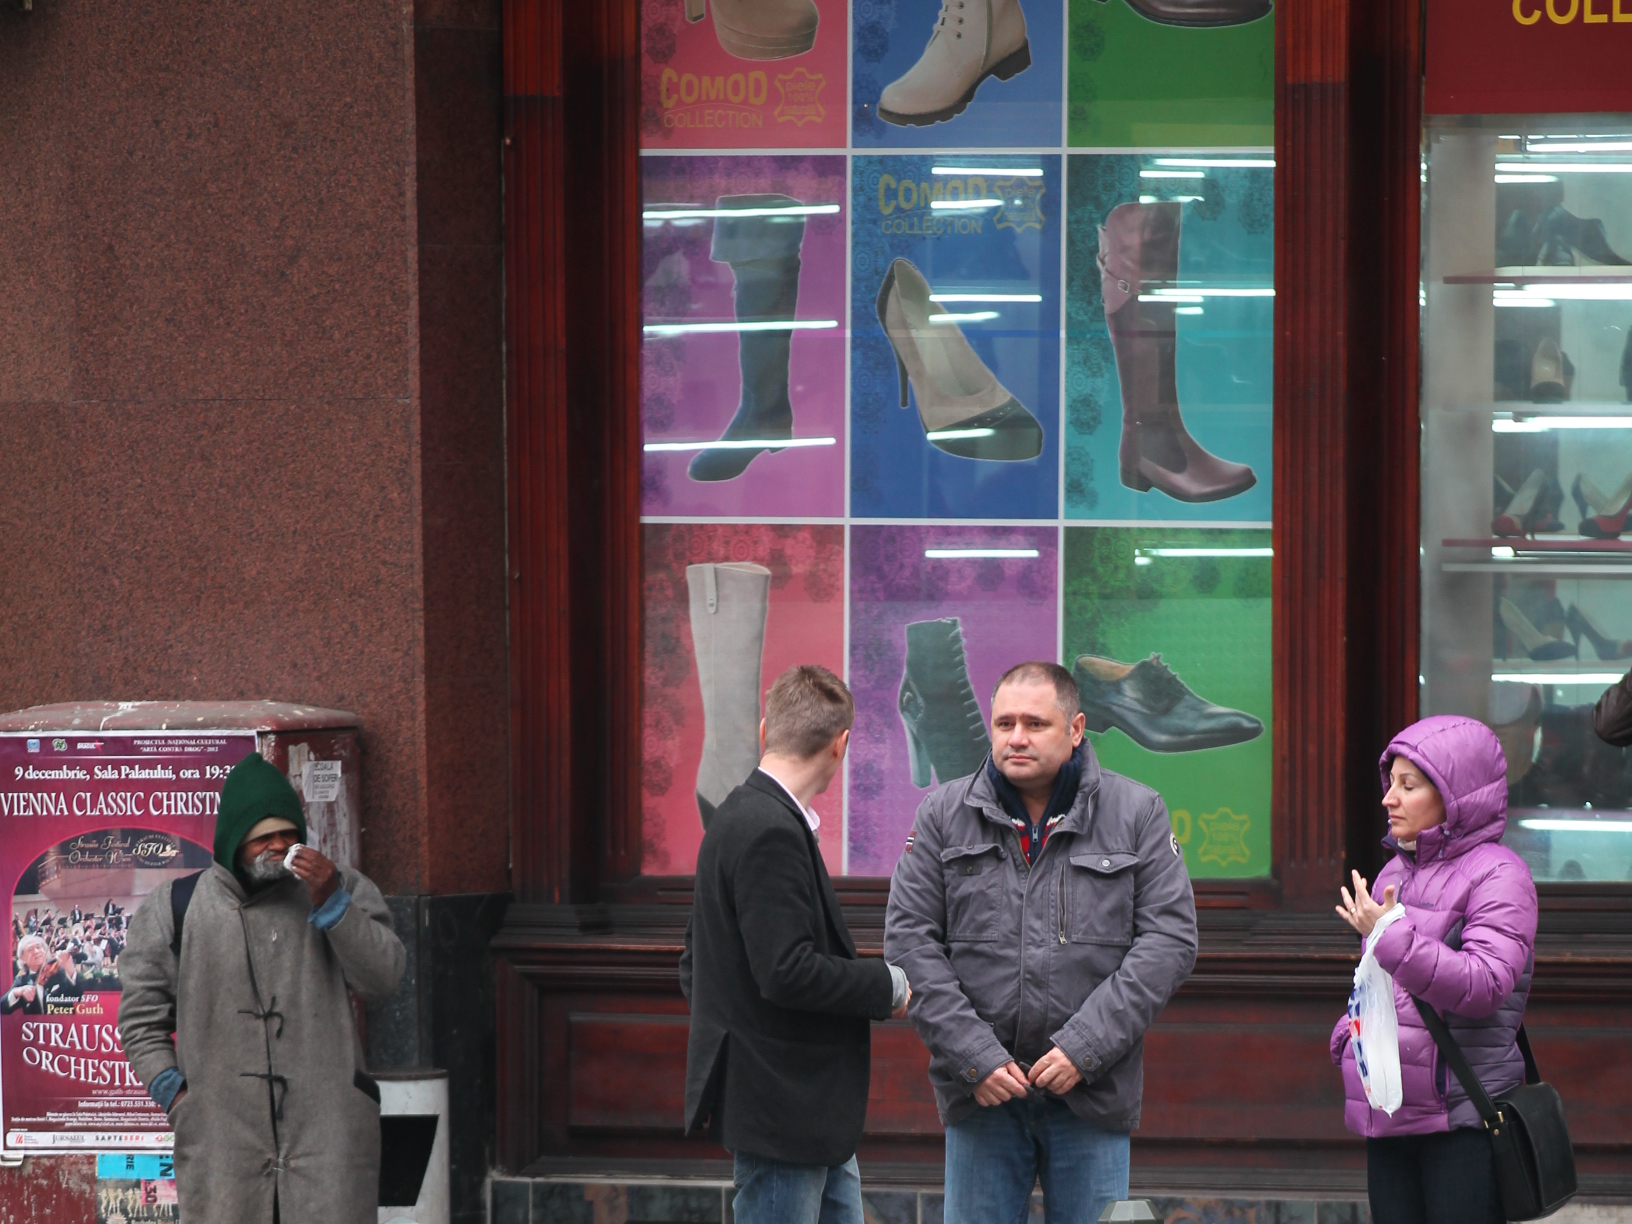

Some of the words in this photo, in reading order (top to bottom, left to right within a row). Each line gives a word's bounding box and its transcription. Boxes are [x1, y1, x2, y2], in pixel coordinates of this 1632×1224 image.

[660, 67, 768, 108] COMOD
[663, 110, 763, 128] COLLECTION
[881, 216, 983, 234] COLLECTION
[14, 765, 24, 780] 9
[24, 764, 90, 780] decembrie,
[94, 764, 120, 779] Sala
[120, 764, 177, 781] Palatului,
[179, 768, 200, 779] ora
[0, 791, 69, 816] VIENNA
[72, 791, 145, 816] CLASSIC
[46, 993, 80, 1002] fondator
[81, 994, 99, 1002] SFO
[47, 1003, 75, 1015] Peter
[76, 1003, 104, 1015] Guth
